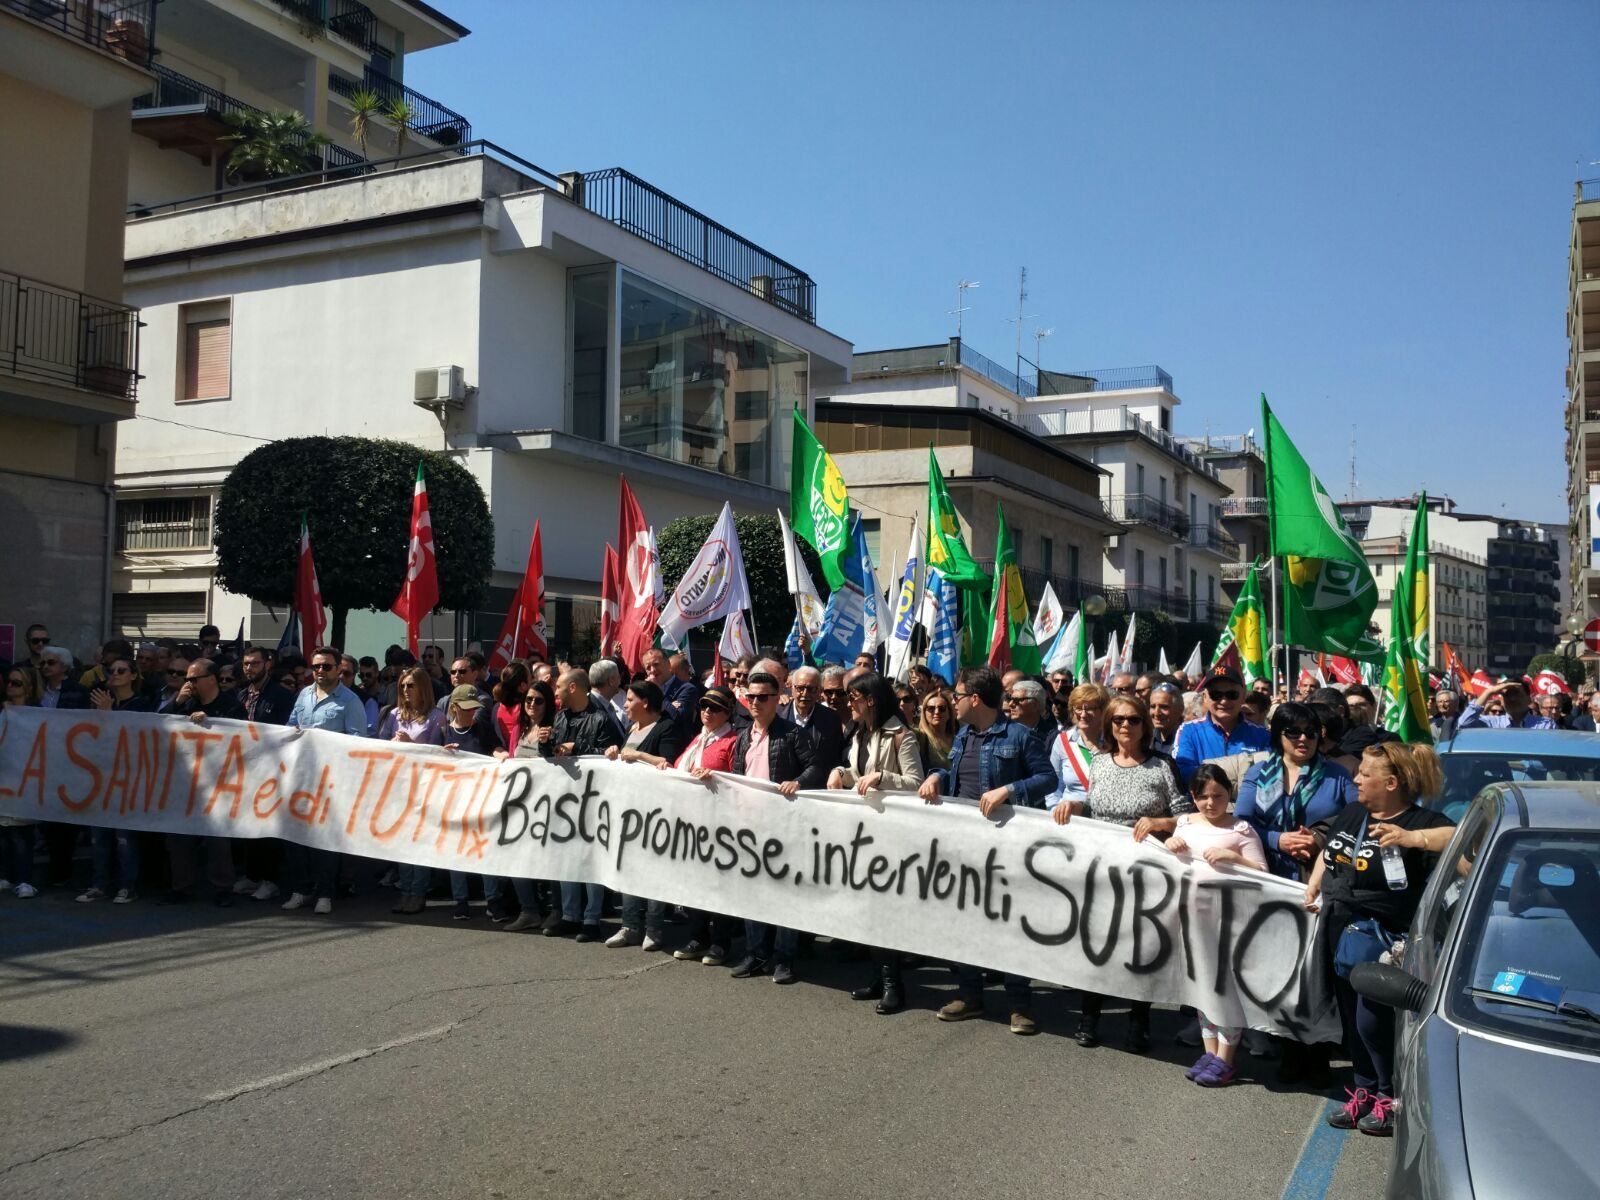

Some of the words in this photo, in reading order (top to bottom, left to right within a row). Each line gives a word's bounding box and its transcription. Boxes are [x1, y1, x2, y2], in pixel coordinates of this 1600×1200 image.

[57, 722, 261, 821] SANITÀ
[288, 764, 335, 826] di
[497, 766, 610, 851] Basta
[811, 821, 1011, 923] interventi
